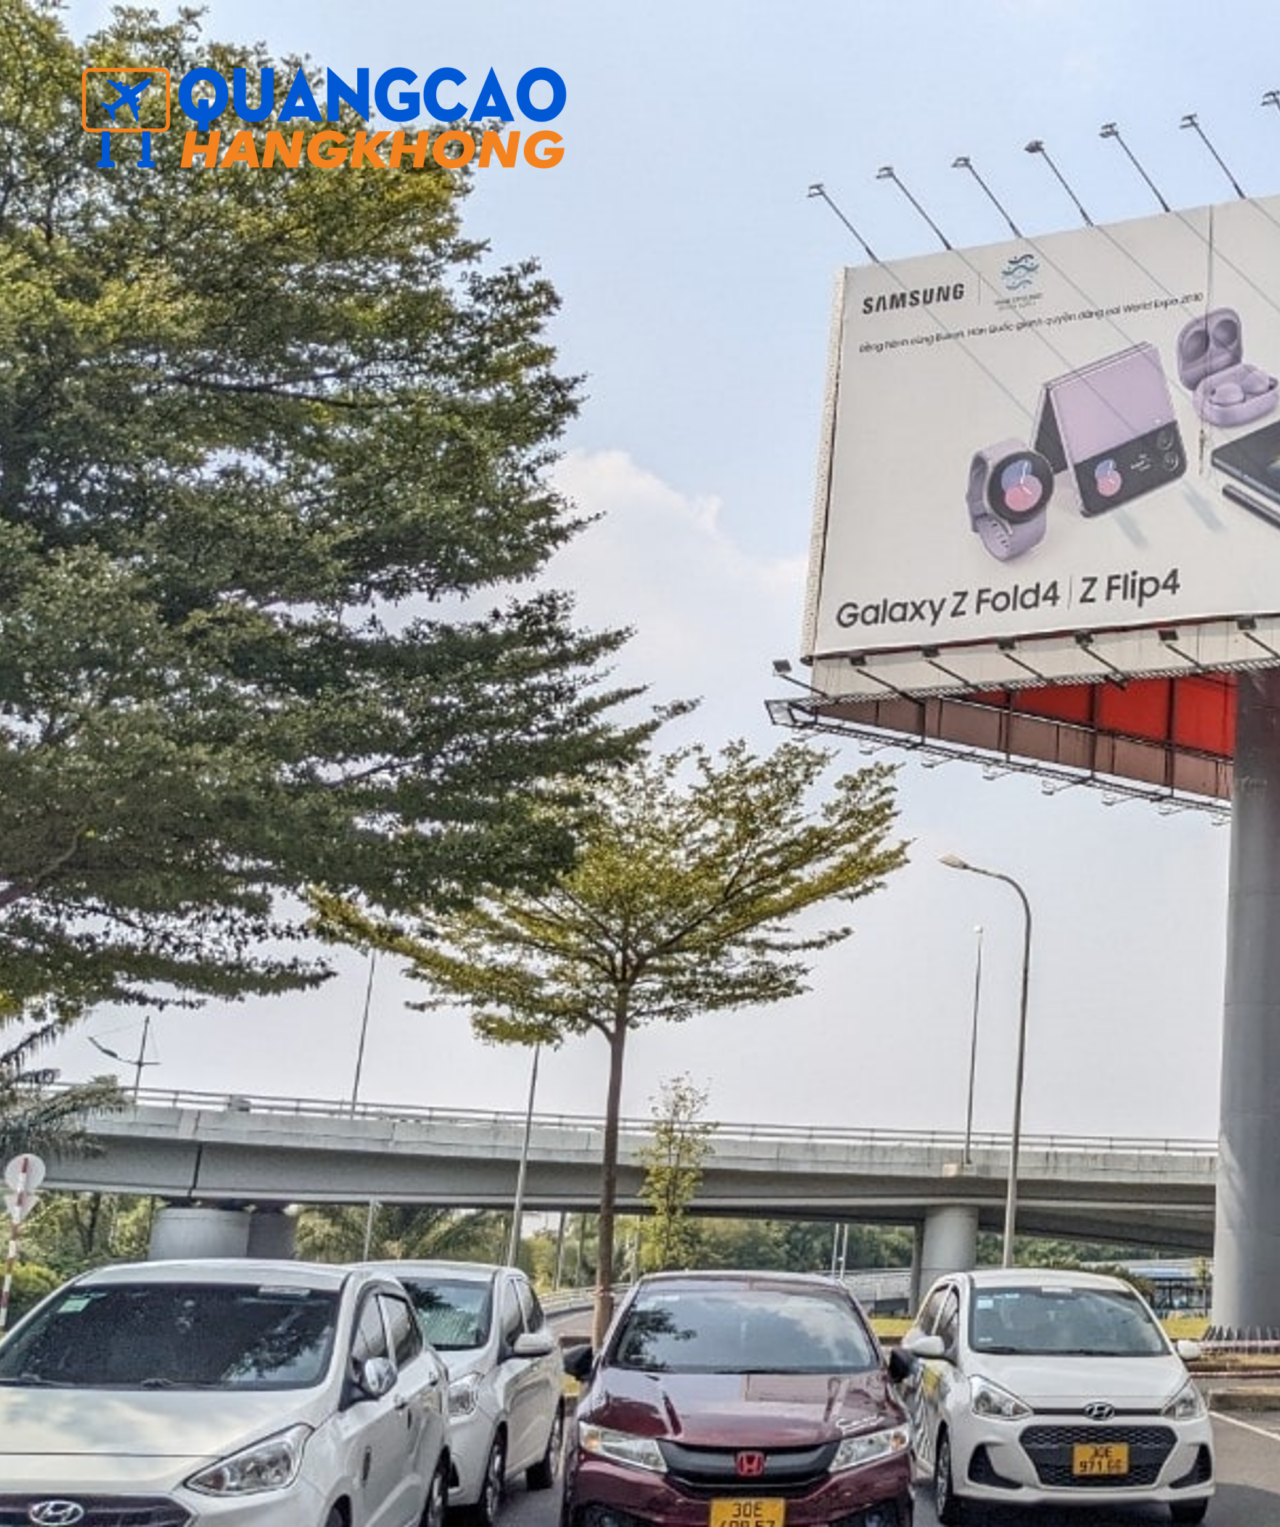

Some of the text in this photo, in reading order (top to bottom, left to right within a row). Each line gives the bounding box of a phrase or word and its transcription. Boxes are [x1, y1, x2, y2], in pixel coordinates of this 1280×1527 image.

[862, 283, 965, 315] SAMSUNG
[836, 568, 1181, 628] Galaxy Z Fold4 Z Flip4
[731, 1502, 764, 1518] 30E
